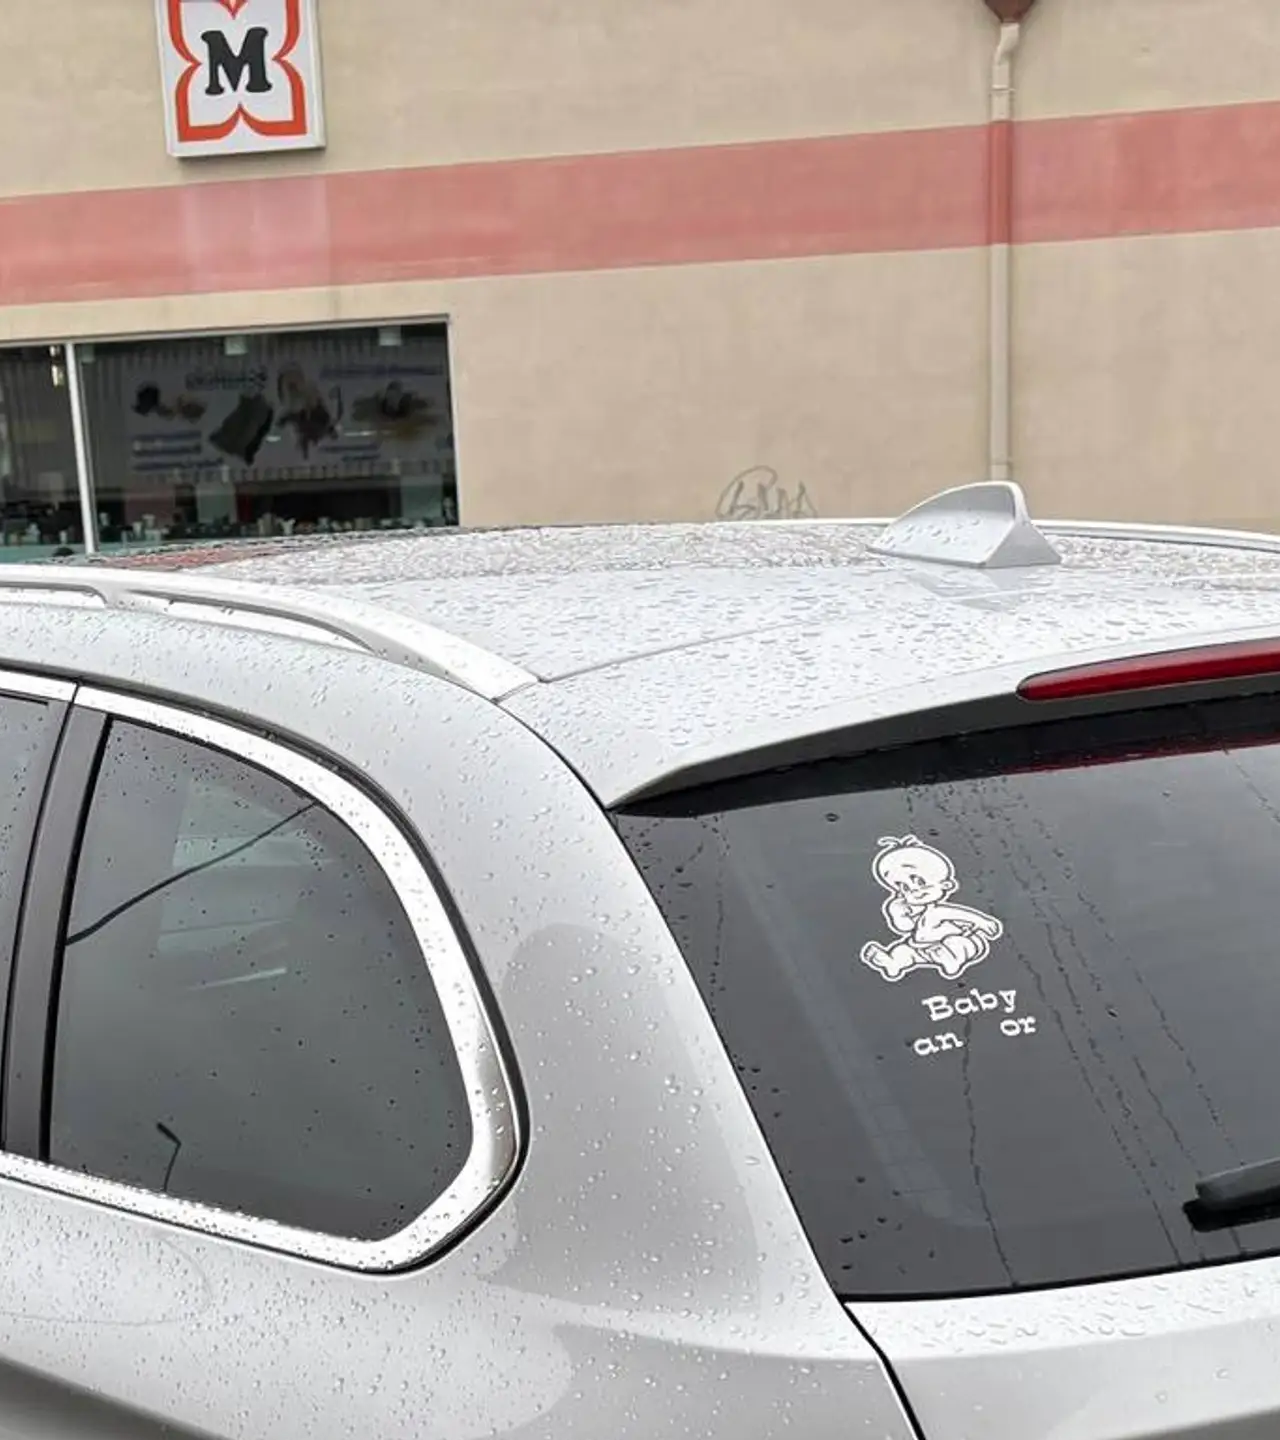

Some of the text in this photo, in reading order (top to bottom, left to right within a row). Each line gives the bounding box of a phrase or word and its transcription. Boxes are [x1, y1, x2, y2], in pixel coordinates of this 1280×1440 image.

[201, 27, 272, 95] M
[921, 988, 1016, 1021] Baby
[913, 1032, 964, 1056] an
